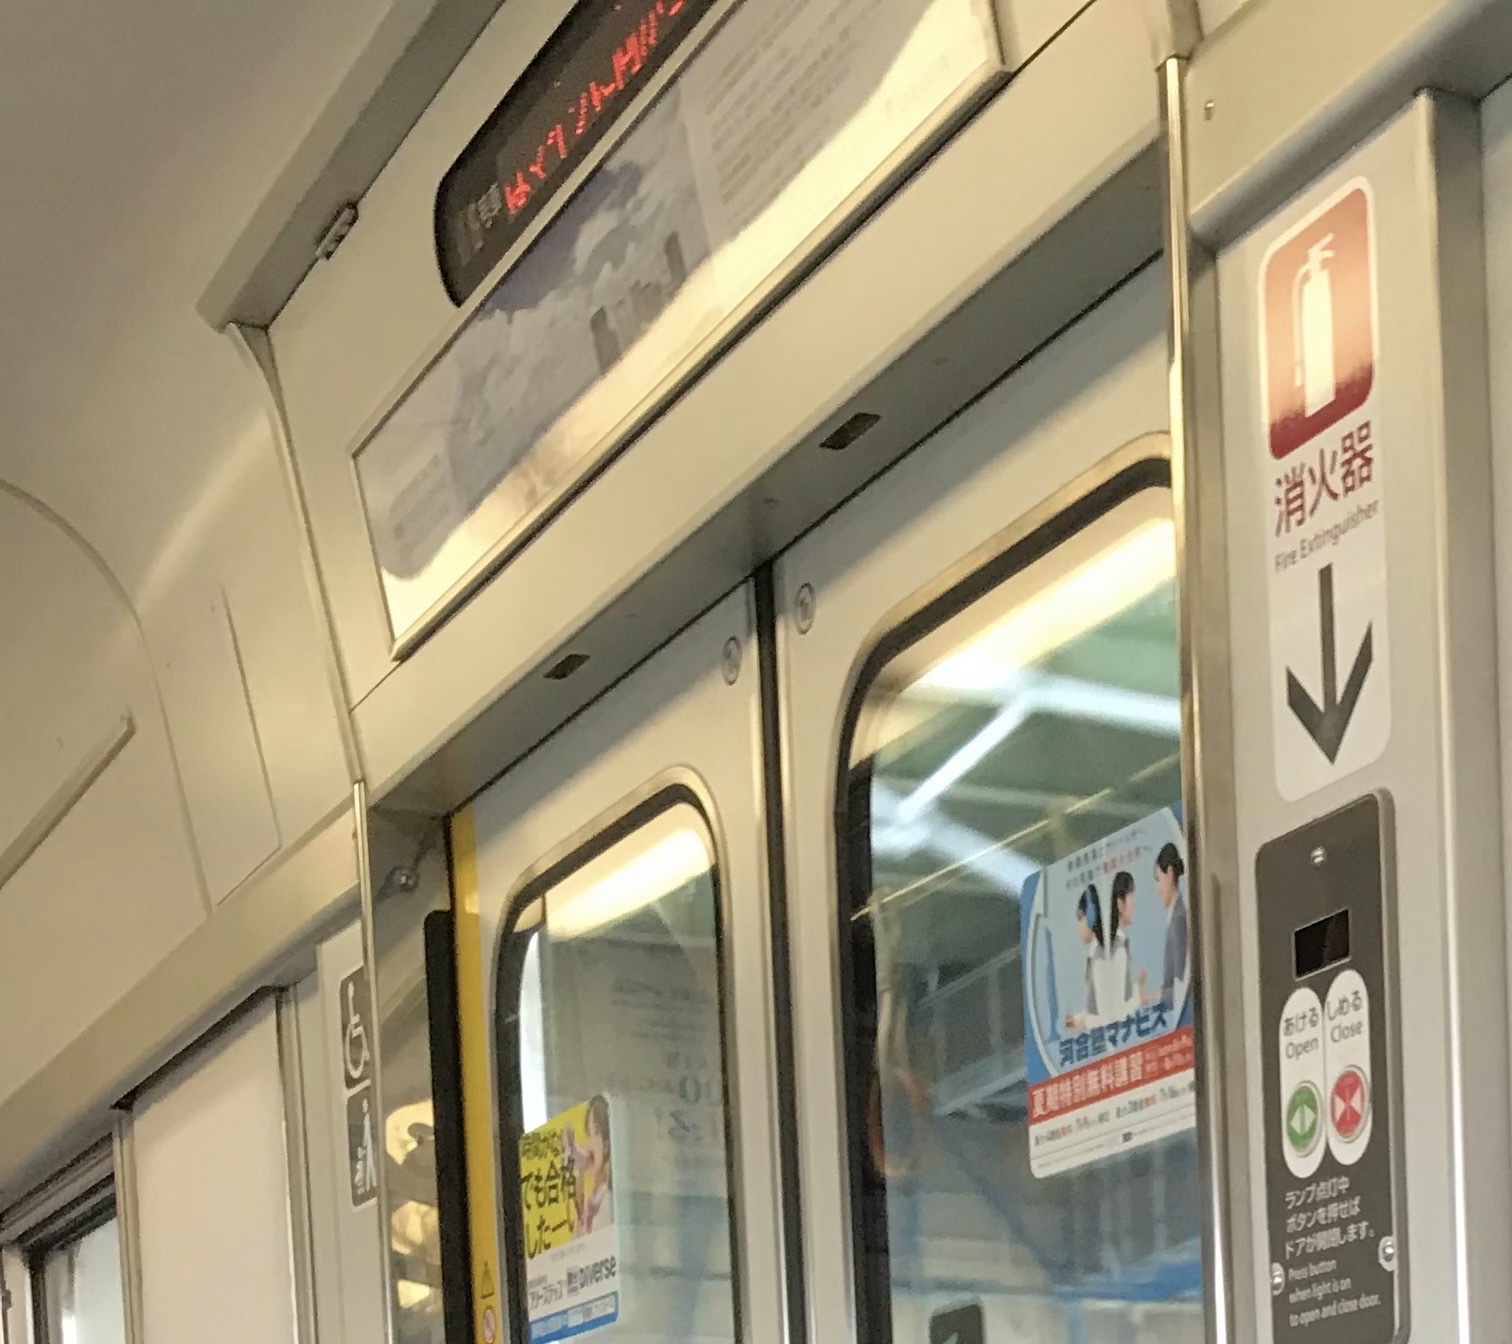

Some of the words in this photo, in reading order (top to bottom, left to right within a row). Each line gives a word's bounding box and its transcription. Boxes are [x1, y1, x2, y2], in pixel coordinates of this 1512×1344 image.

[1274, 420, 1373, 538] 消火器
[1275, 549, 1297, 574] Fire
[1300, 499, 1380, 559] Extinguisher
[1327, 990, 1362, 1021] しめる
[1283, 1007, 1319, 1037] あける
[1330, 1020, 1363, 1043] Close
[1285, 1038, 1319, 1061] Open
[1288, 1267, 1308, 1281] Press
[1308, 1259, 1337, 1277] button
[1289, 1287, 1311, 1304] when
[1312, 1281, 1331, 1301] light
[1340, 1277, 1351, 1291] on
[1289, 1312, 1299, 1328] to
[1300, 1308, 1320, 1327] open
[1321, 1300, 1337, 1319] and
[1338, 1298, 1358, 1315] close
